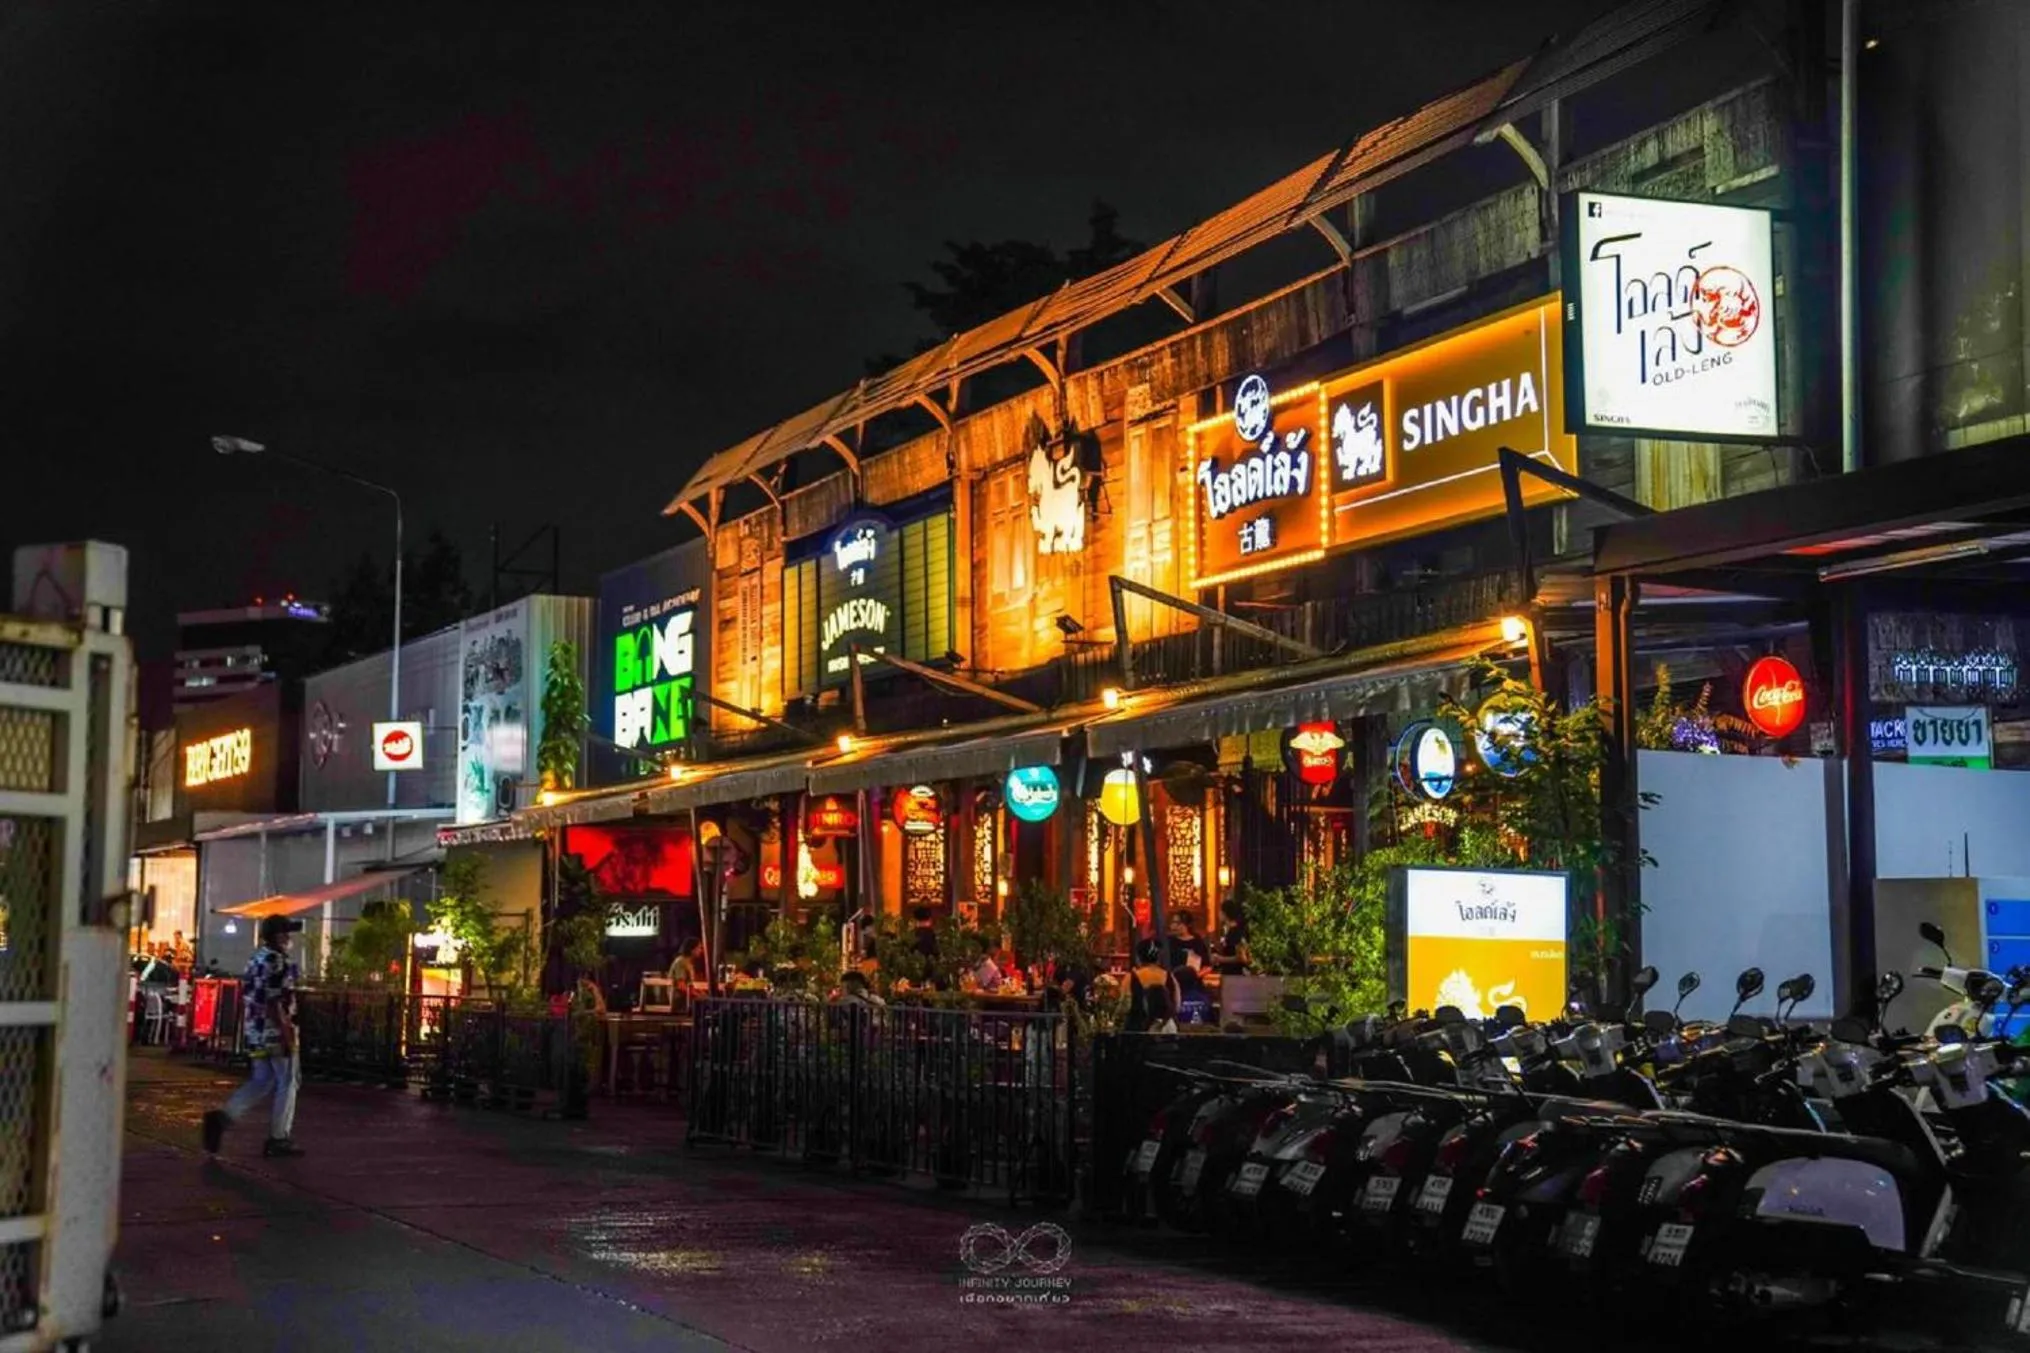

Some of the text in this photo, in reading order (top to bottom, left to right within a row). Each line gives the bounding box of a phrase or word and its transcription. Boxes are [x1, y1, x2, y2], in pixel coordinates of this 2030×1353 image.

[1652, 351, 1734, 387] OLD-LENG
[1401, 370, 1540, 452] SINGHA
[821, 598, 888, 651] JAMESON
[1752, 679, 1805, 710] Coca-Cola
[1912, 718, 1983, 747] ขายยา
